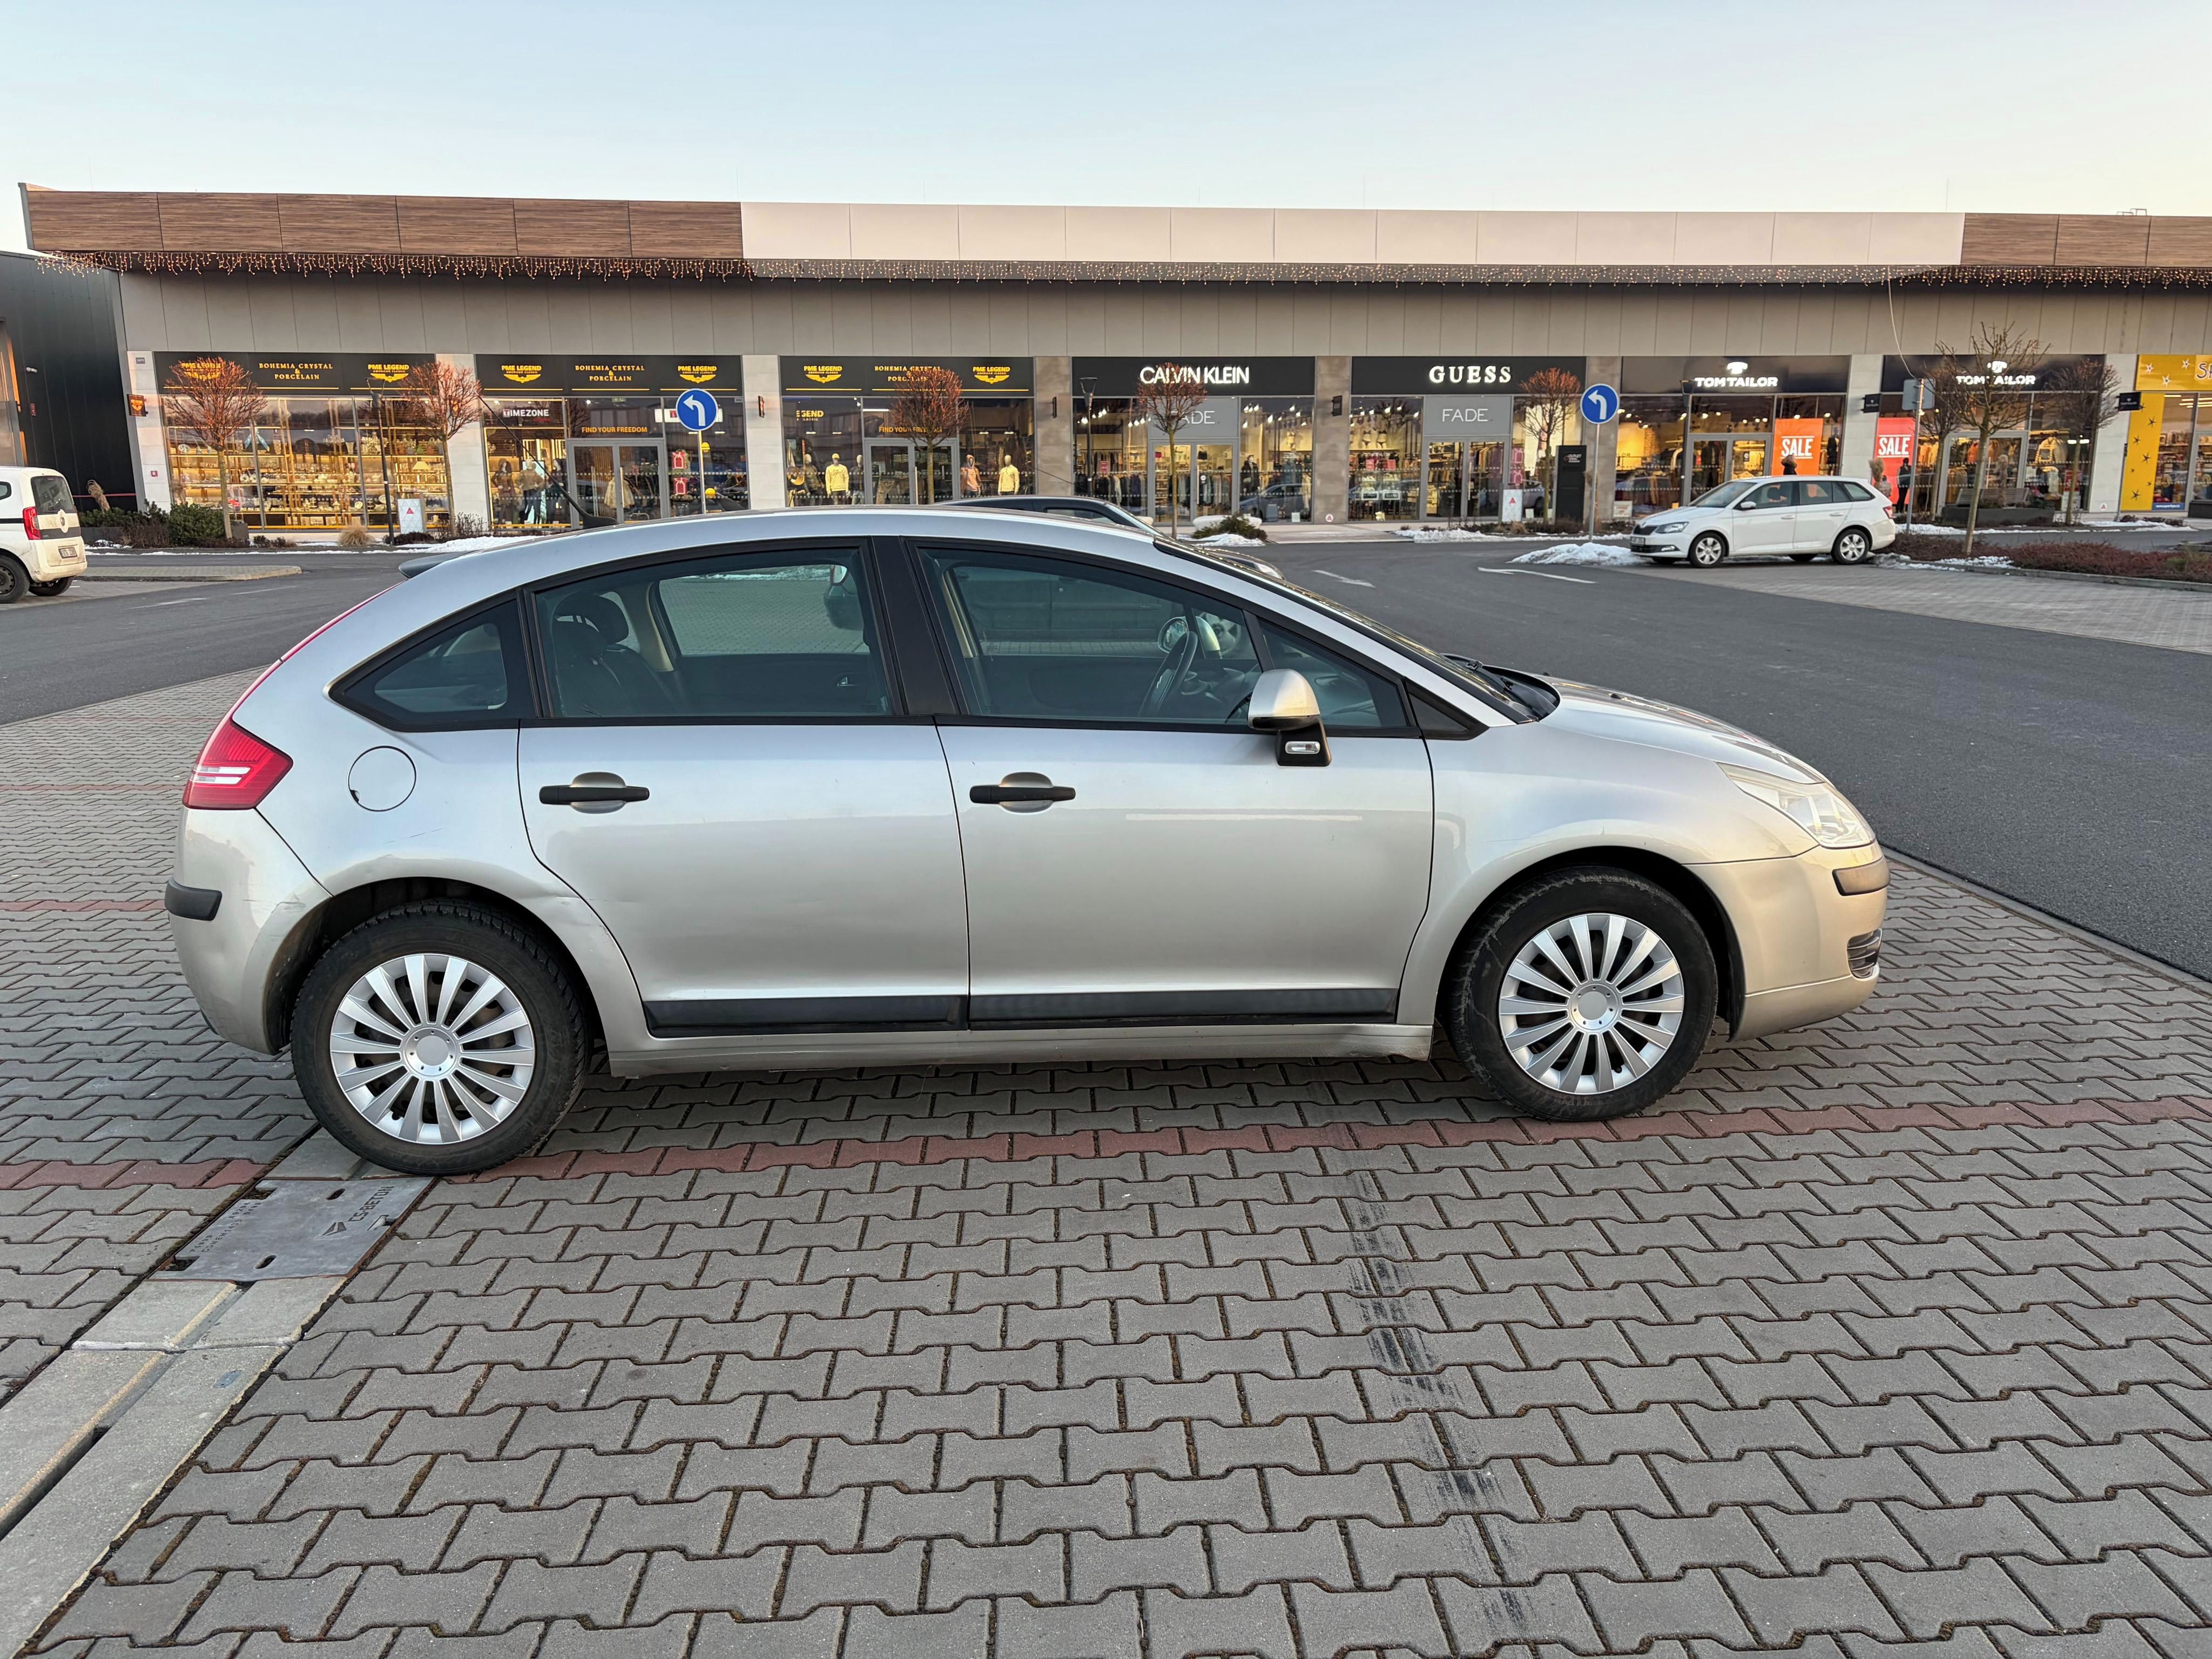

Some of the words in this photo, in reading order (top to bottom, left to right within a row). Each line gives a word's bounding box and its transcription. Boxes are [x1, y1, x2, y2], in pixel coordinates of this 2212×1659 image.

[1139, 366, 1201, 384] CALVIN
[1204, 366, 1250, 384] KLEIN
[1429, 366, 1512, 383] GUESS
[1694, 377, 1726, 387] TOM
[1727, 377, 1778, 387] TAILOR
[503, 409, 550, 418] TIMEZONE
[1781, 437, 1814, 457] SALE
[1878, 436, 1911, 456] SALE
